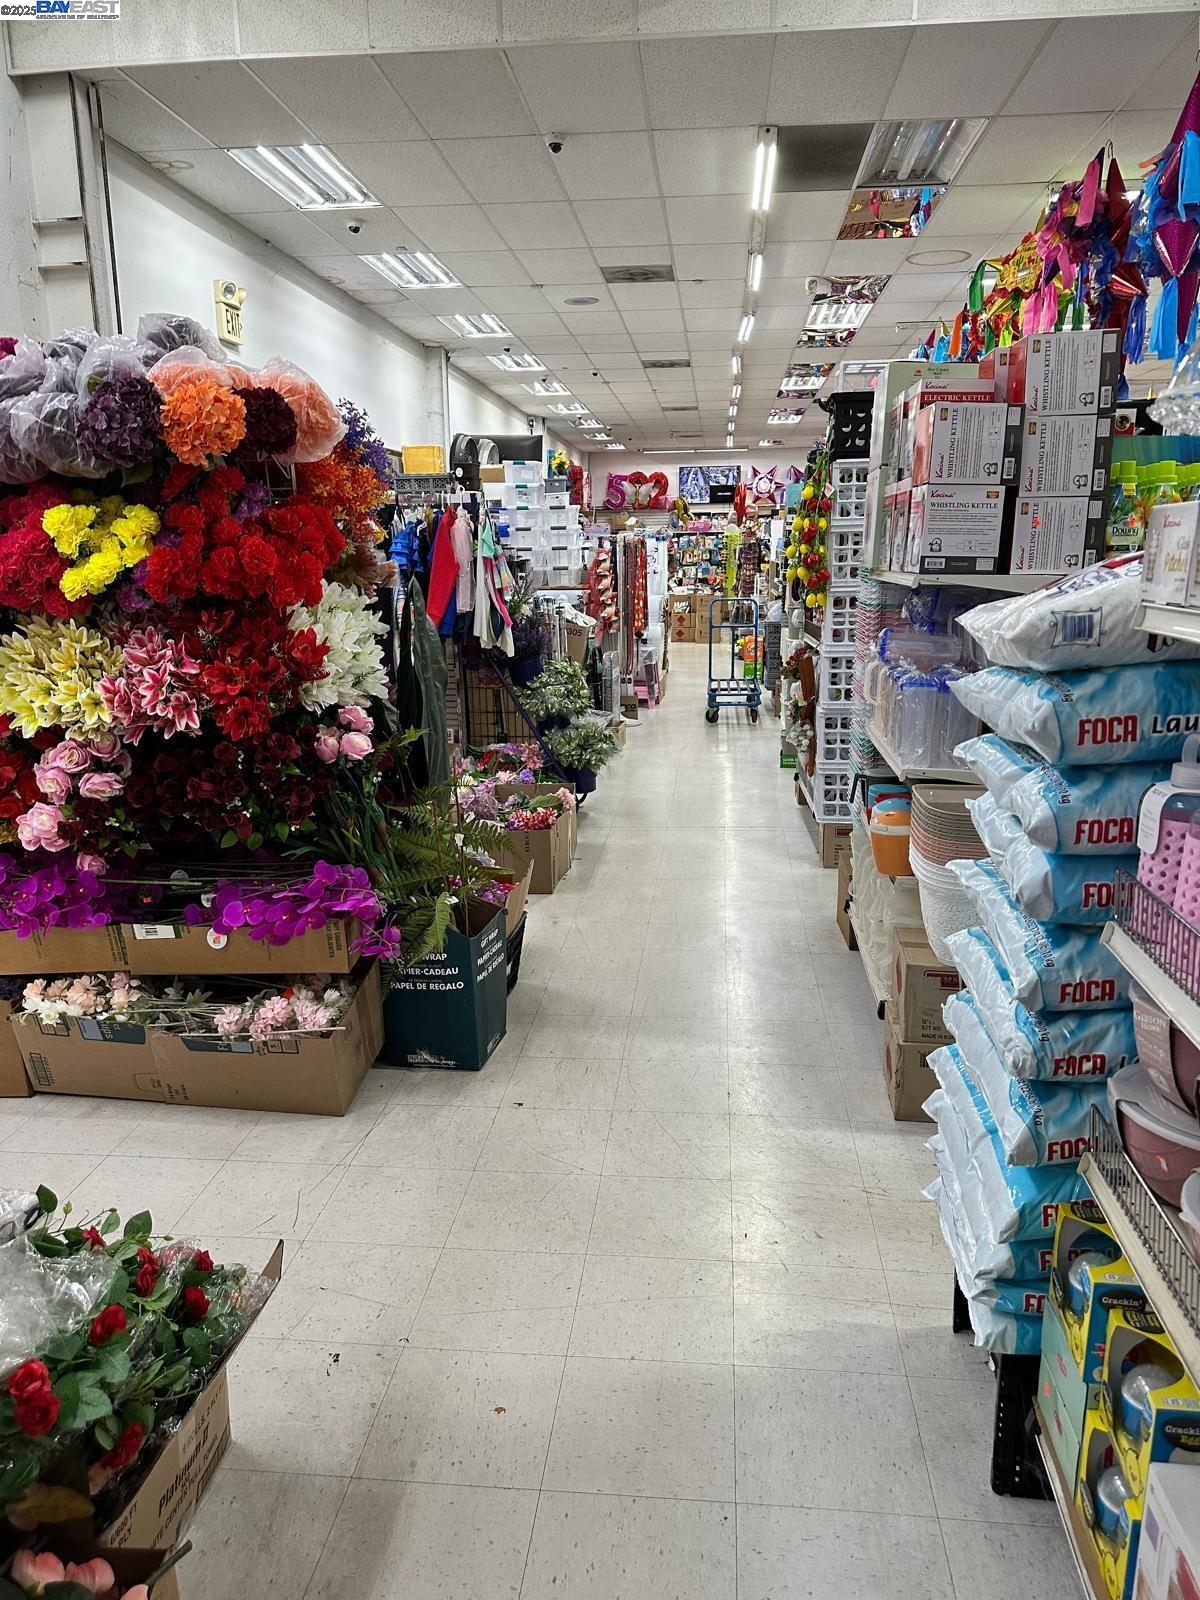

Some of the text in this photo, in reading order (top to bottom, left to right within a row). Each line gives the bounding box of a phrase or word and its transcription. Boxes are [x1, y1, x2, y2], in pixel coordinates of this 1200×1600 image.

[225, 308, 241, 338] EXIT
[1042, 369, 1050, 411] WHISTLING
[947, 408, 959, 479] WHISTLING KETTLE
[1036, 450, 1045, 492] WHISTLING
[1028, 502, 1040, 570] WHISTLING KTTLE
[1112, 526, 1139, 537] Downy
[567, 627, 583, 637] 305
[1077, 715, 1138, 746] FOCA
[1074, 817, 1134, 845] FOCA
[416, 982, 427, 990] DE
[429, 981, 464, 991] REGALO
[1059, 979, 1115, 1003] FOCA
[1135, 1011, 1167, 1027] GIBSON
[1052, 1054, 1106, 1077] FOCA
[1024, 1293, 1046, 1313] FO
[1102, 1296, 1142, 1306] Crackin'
[159, 1449, 200, 1518] Platinum
[129, 1500, 138, 1519] FT
[118, 1523, 133, 1548] PLY
